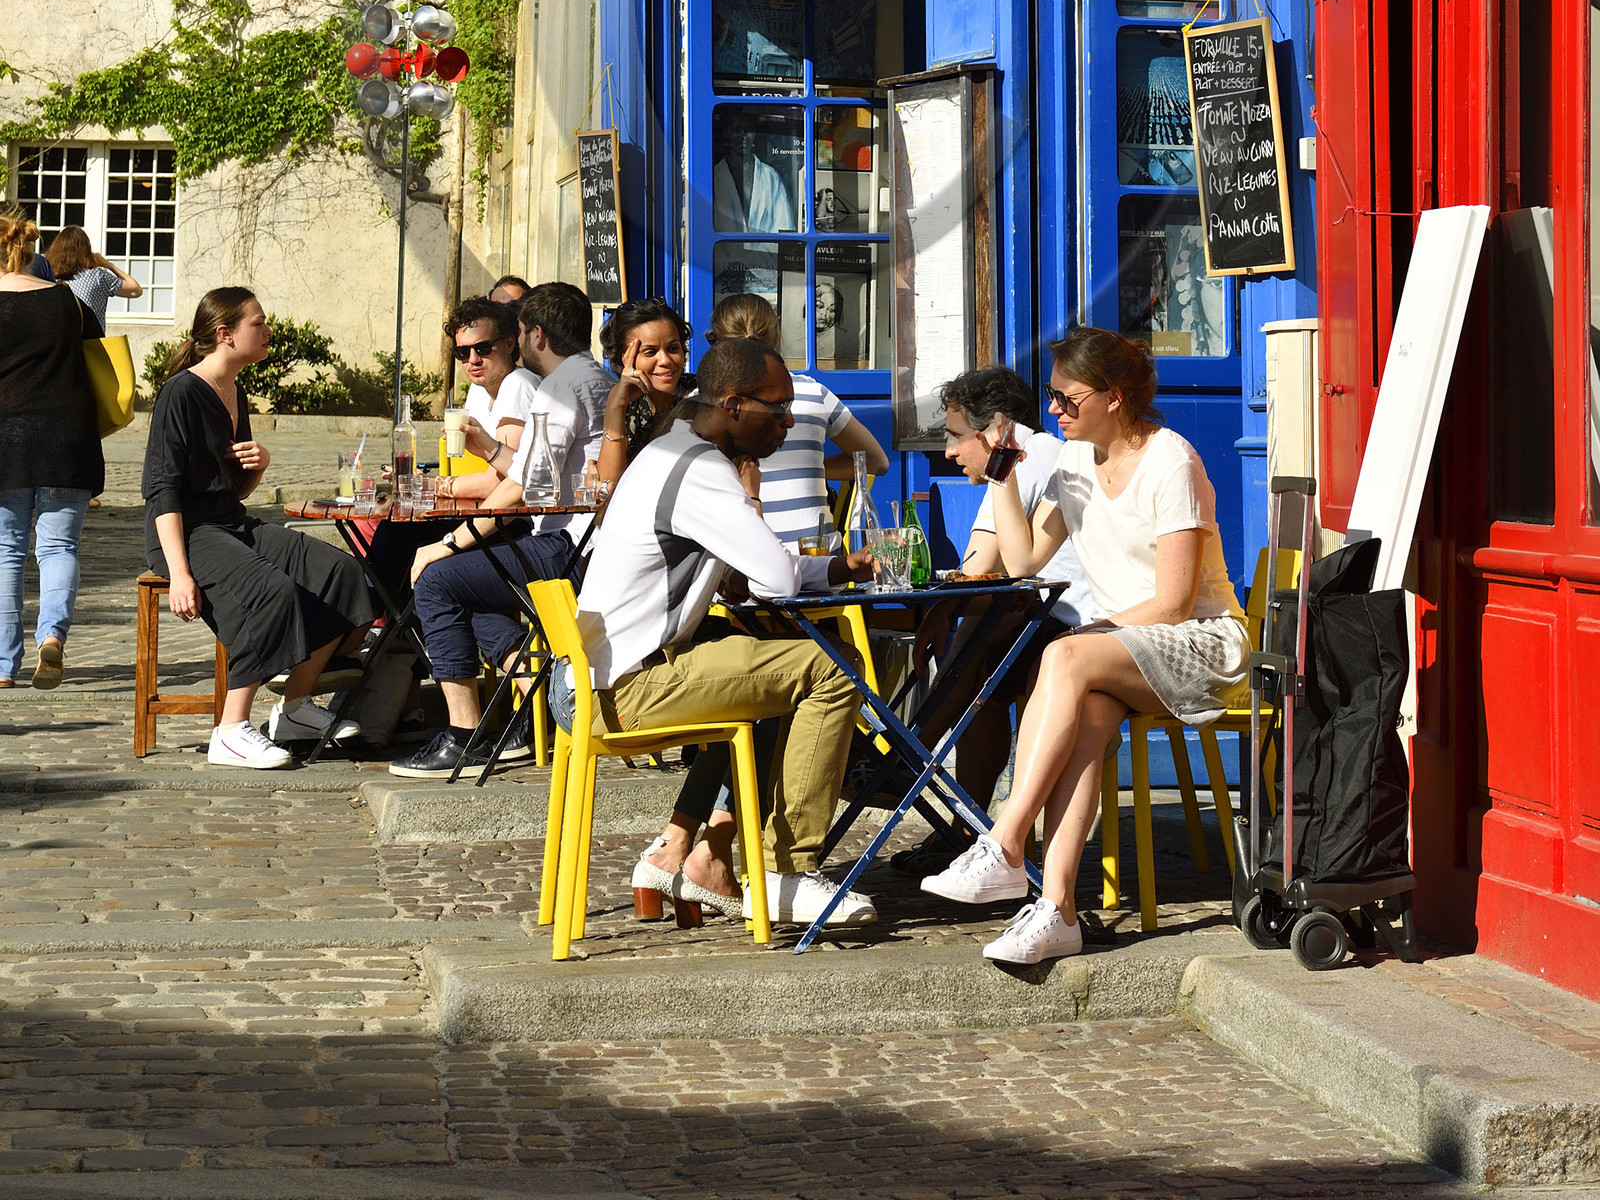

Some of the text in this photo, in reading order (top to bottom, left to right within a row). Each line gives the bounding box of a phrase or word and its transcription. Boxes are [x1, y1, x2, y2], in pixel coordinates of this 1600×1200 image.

[1220, 76, 1258, 90] DESSERT
[772, 147, 779, 155] 16
[1237, 147, 1250, 162] AU
[1208, 212, 1251, 242] PANNA
[816, 246, 845, 254] AVLEUR
